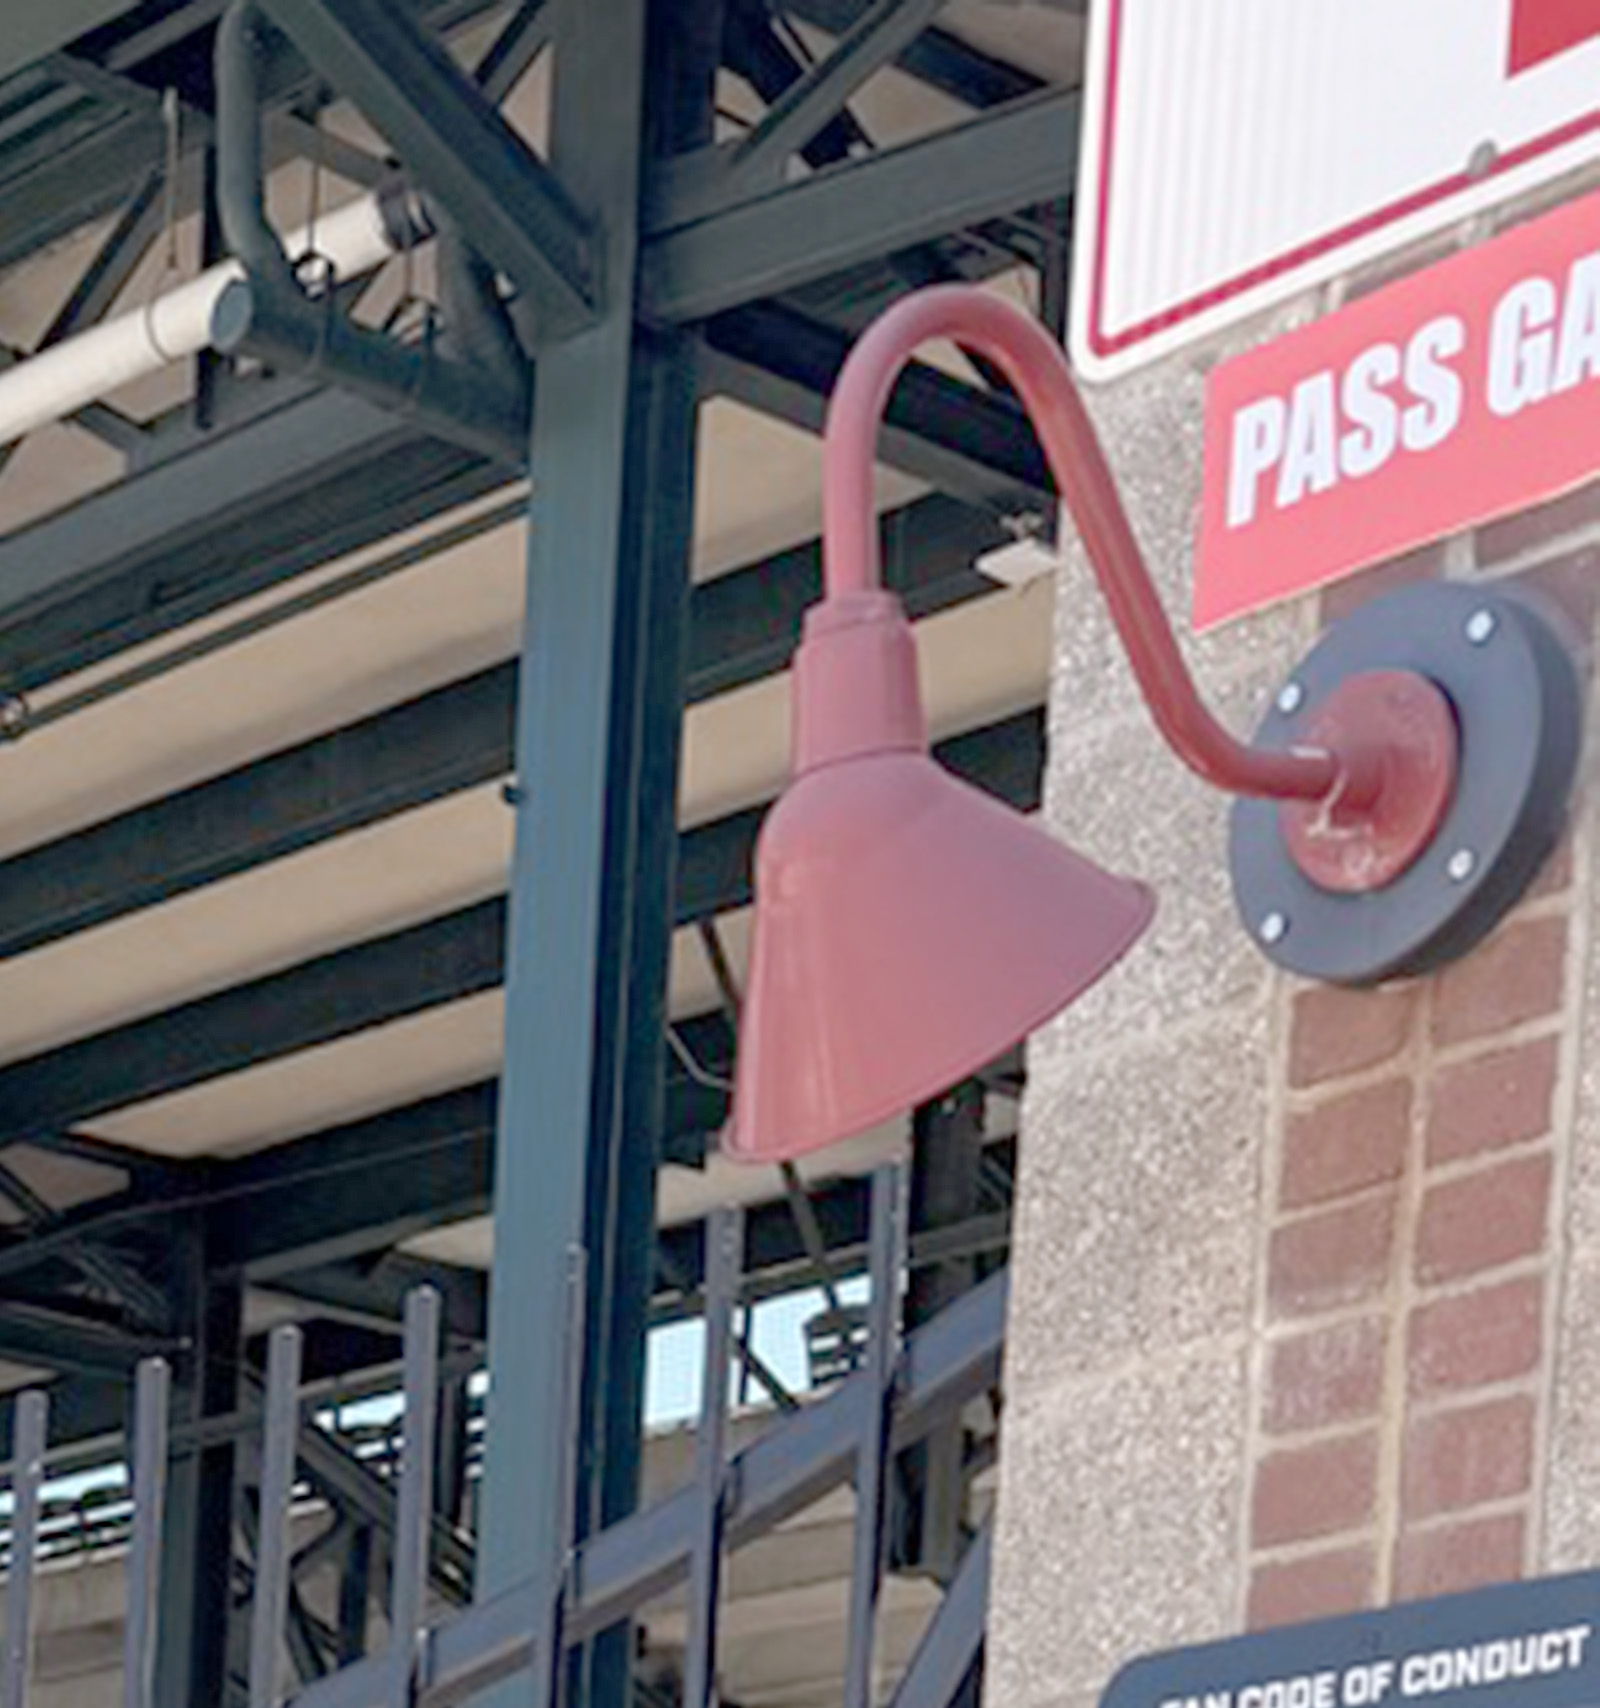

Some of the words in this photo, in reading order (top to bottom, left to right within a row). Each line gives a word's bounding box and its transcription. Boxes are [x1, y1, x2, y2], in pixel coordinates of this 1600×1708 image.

[1225, 315, 1466, 528] PASS
[1343, 1661, 1393, 1706] OF
[1402, 1625, 1590, 1696] CONDUCT
